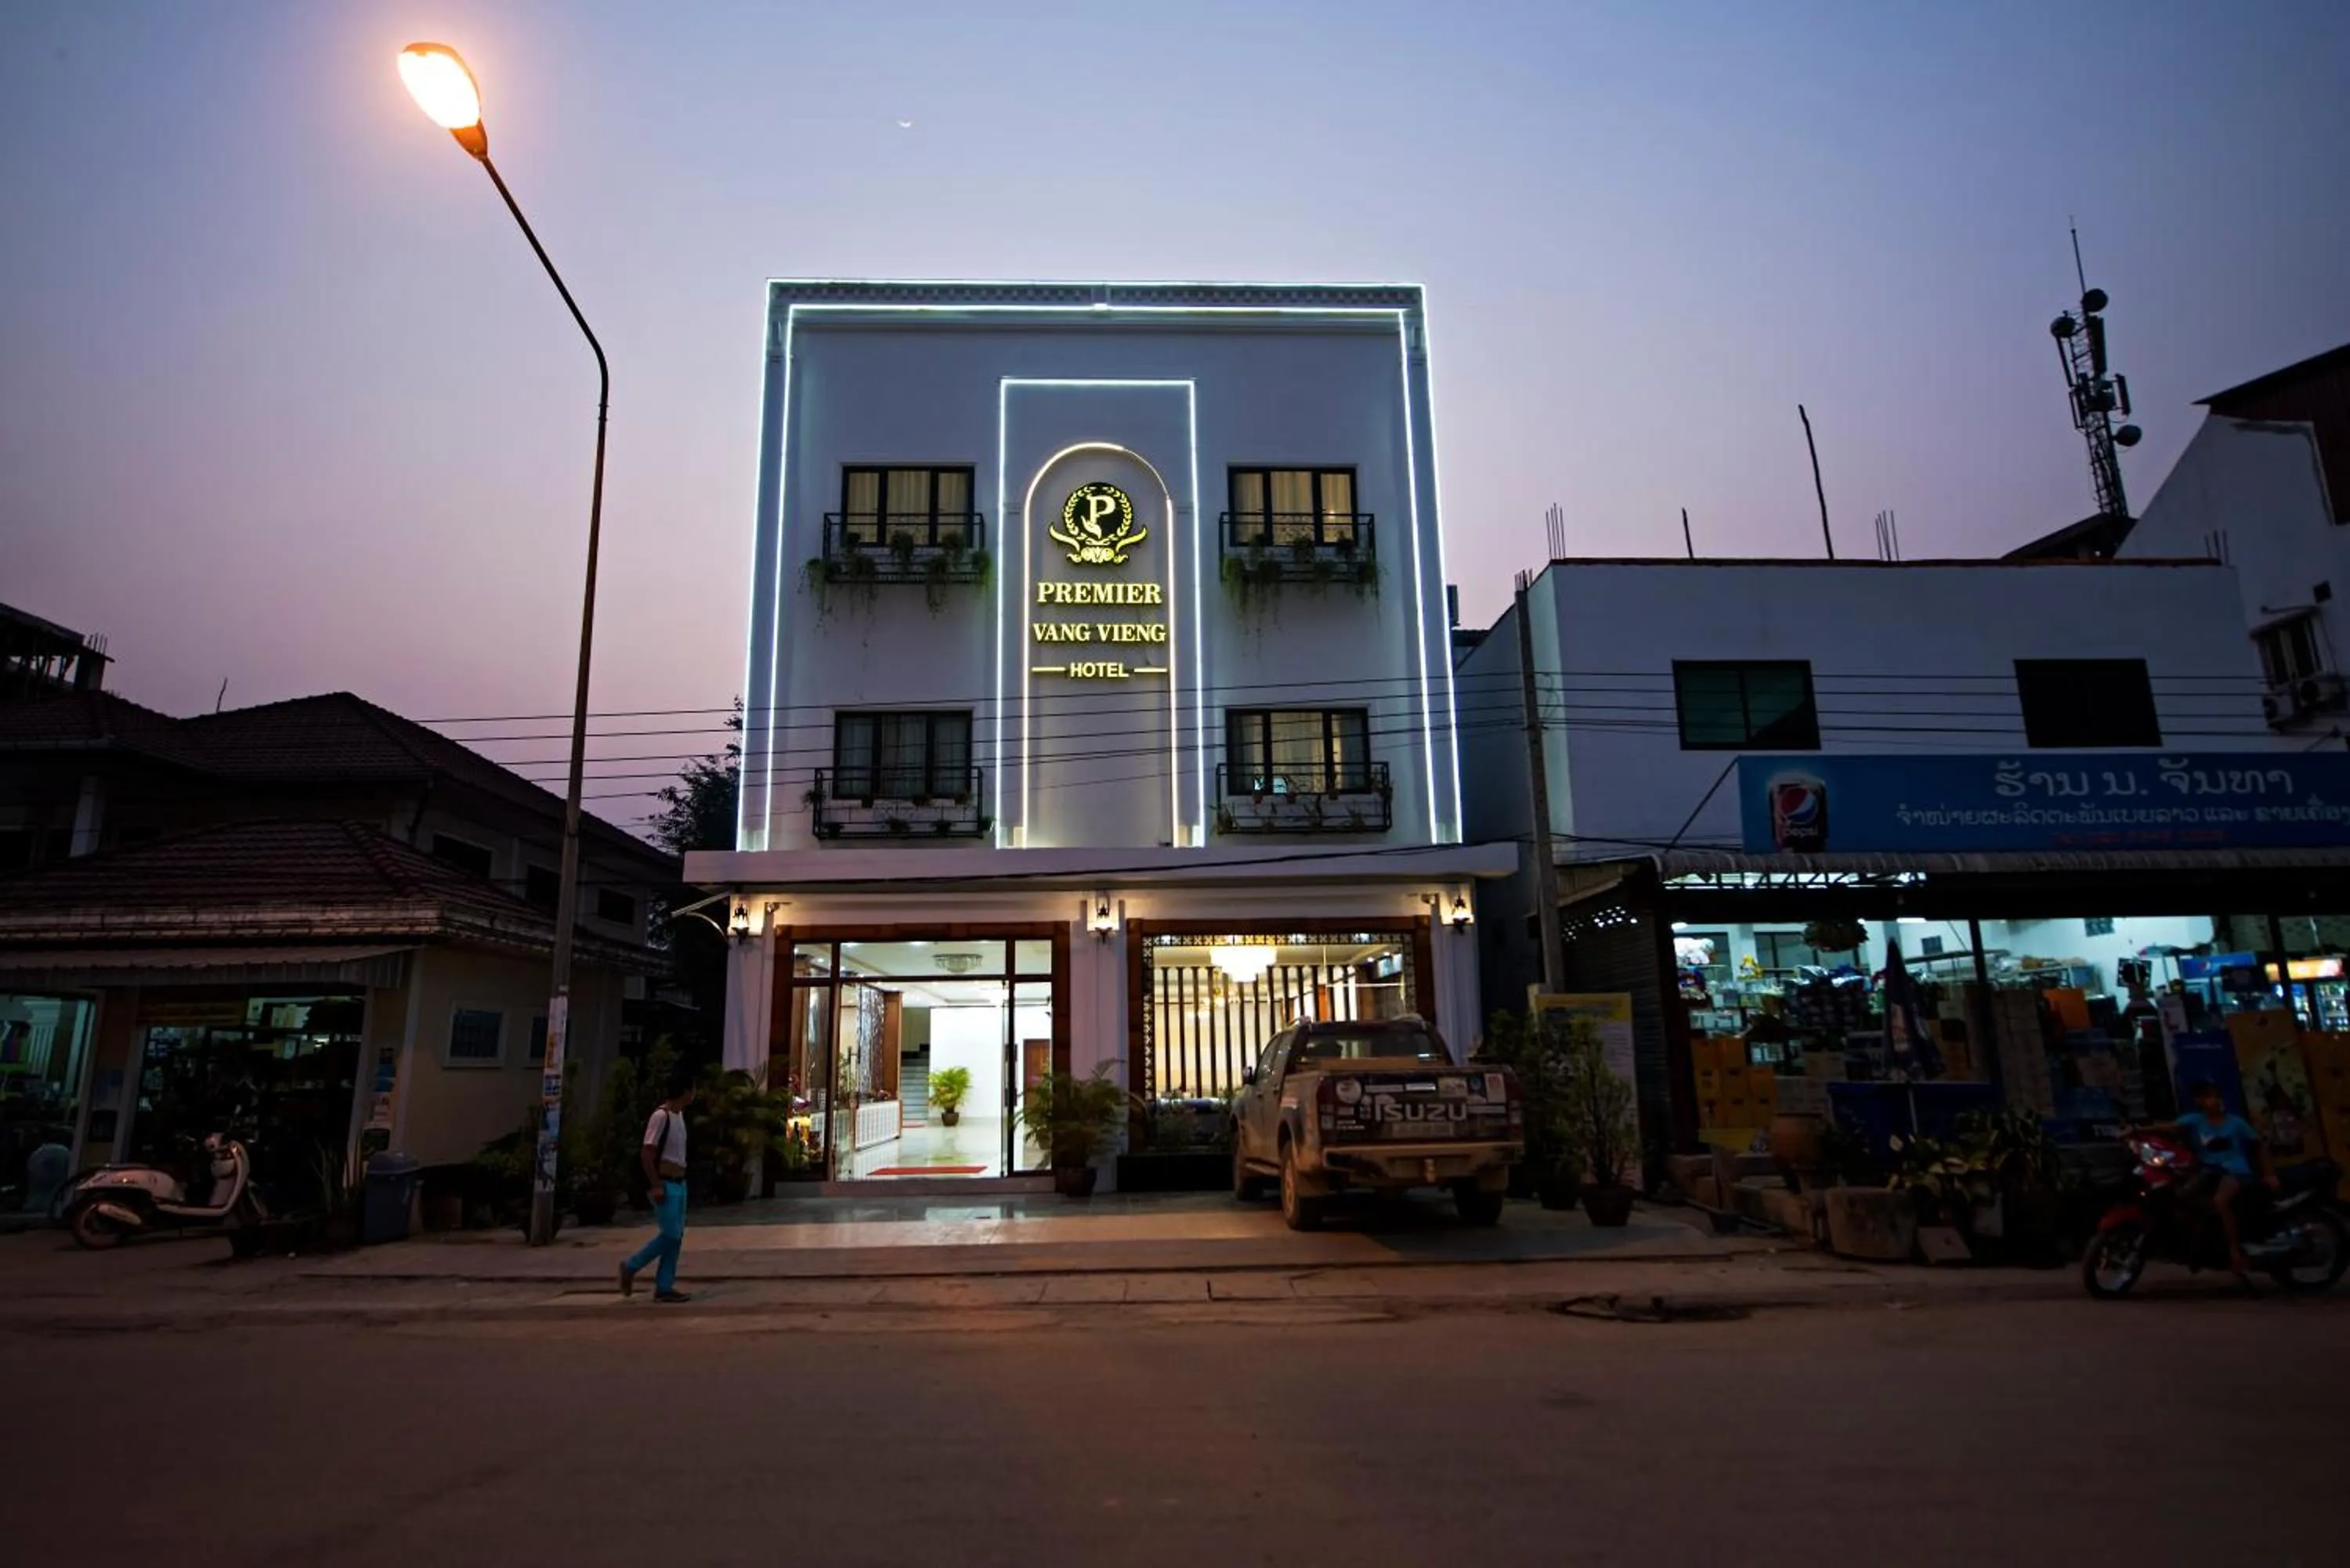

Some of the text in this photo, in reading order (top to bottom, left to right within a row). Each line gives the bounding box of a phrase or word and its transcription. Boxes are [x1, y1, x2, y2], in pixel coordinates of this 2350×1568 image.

[1036, 582, 1163, 605] PREMIER
[1032, 623, 1166, 642] VANG VIENG
[1069, 662, 1130, 677] HOTEL
[1374, 1100, 1468, 1122] ISUZU
